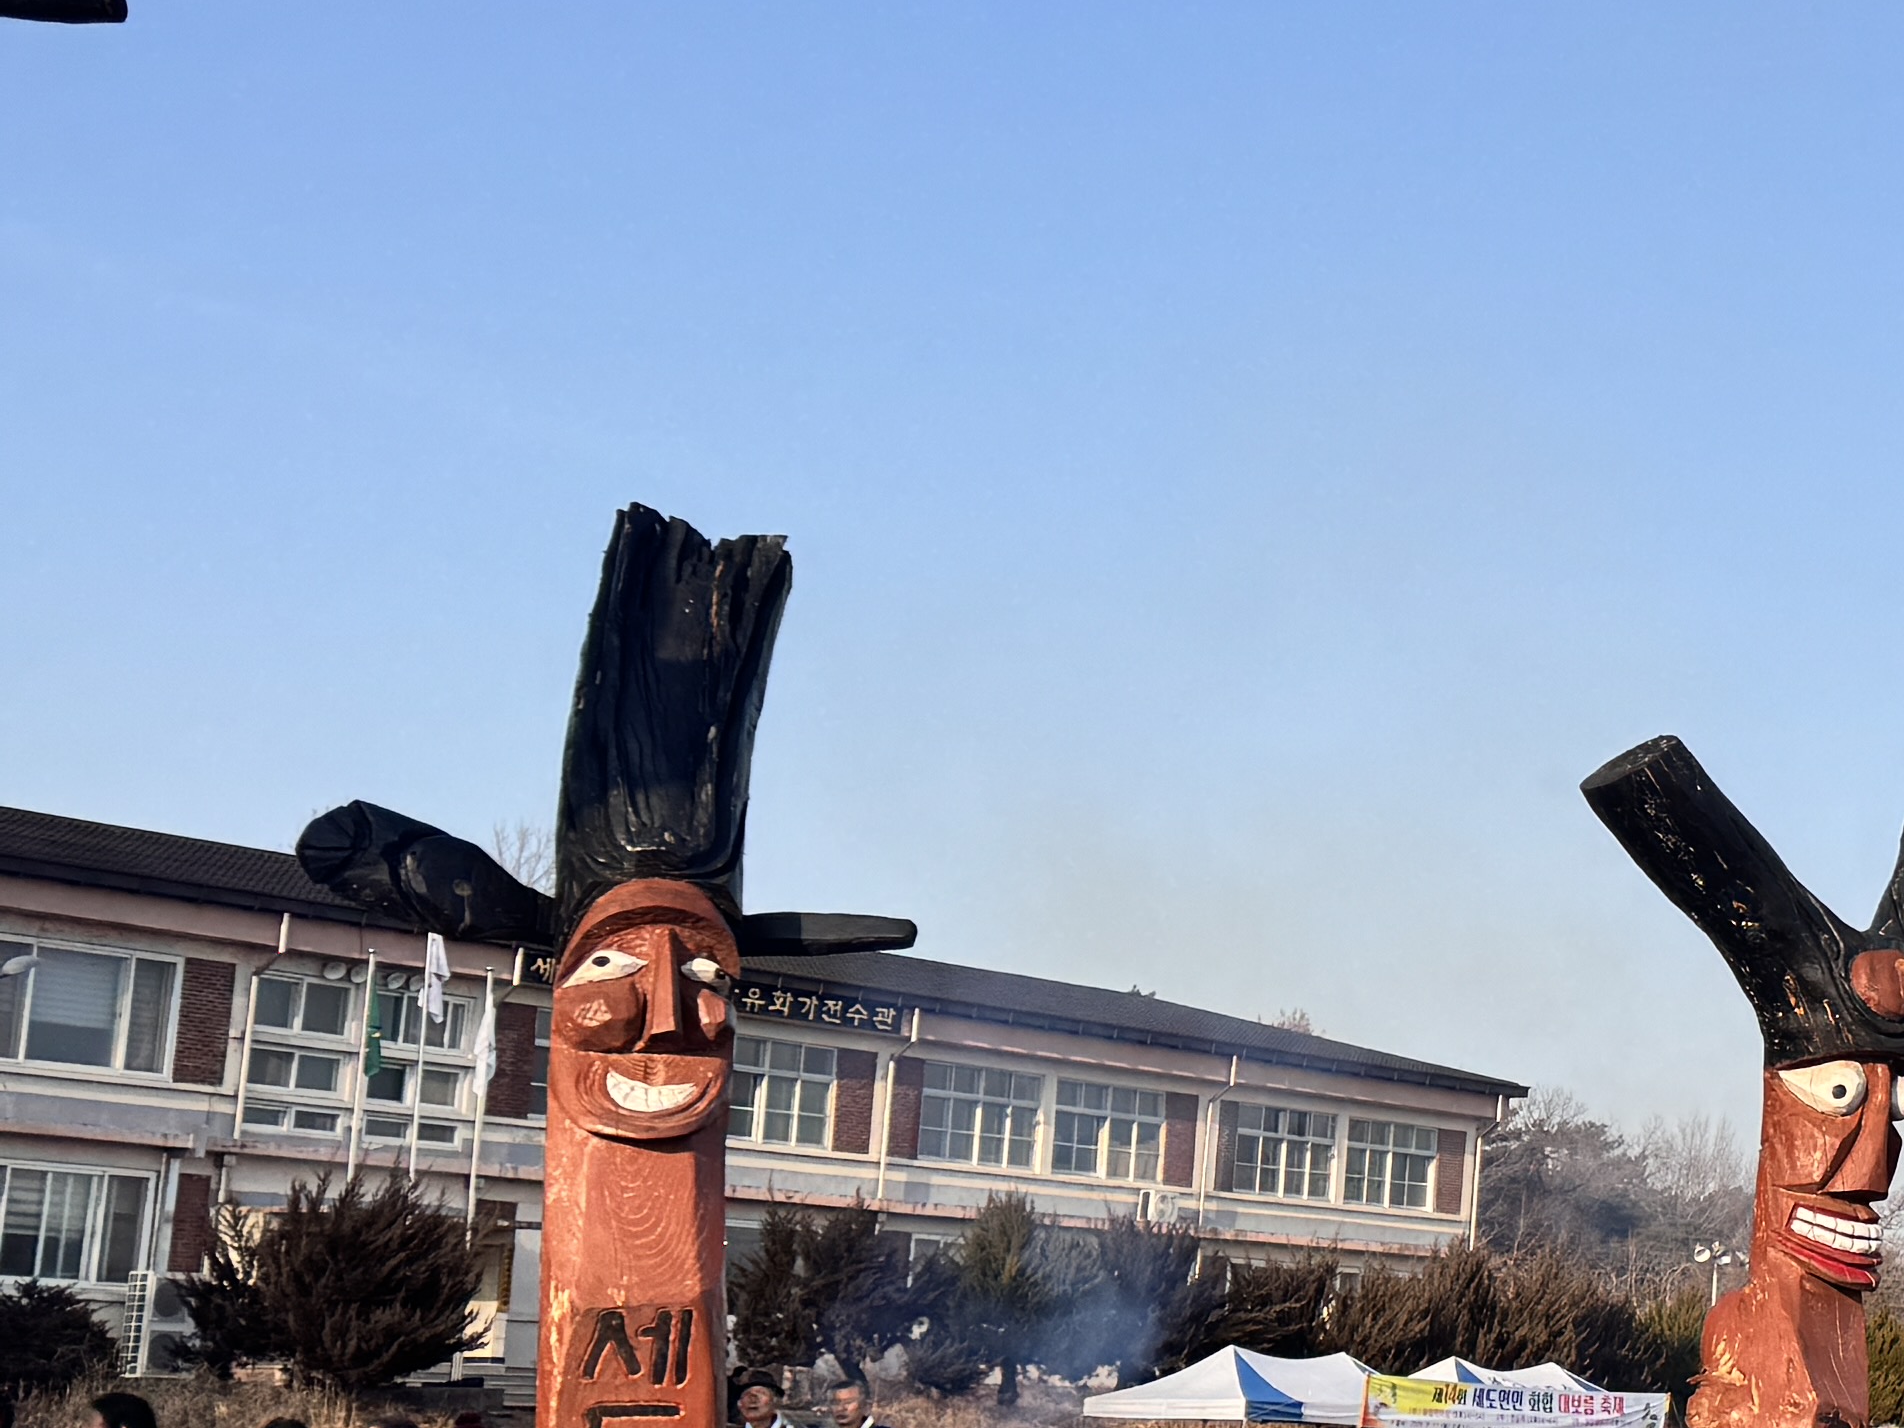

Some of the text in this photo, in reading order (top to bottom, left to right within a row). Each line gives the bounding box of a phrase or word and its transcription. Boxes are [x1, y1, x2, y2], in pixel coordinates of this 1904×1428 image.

[1432, 1383, 1467, 1405] 제14회
[1528, 1391, 1553, 1413] 화합
[1558, 1393, 1595, 1415] 대보름
[1601, 1394, 1625, 1416] 축제
